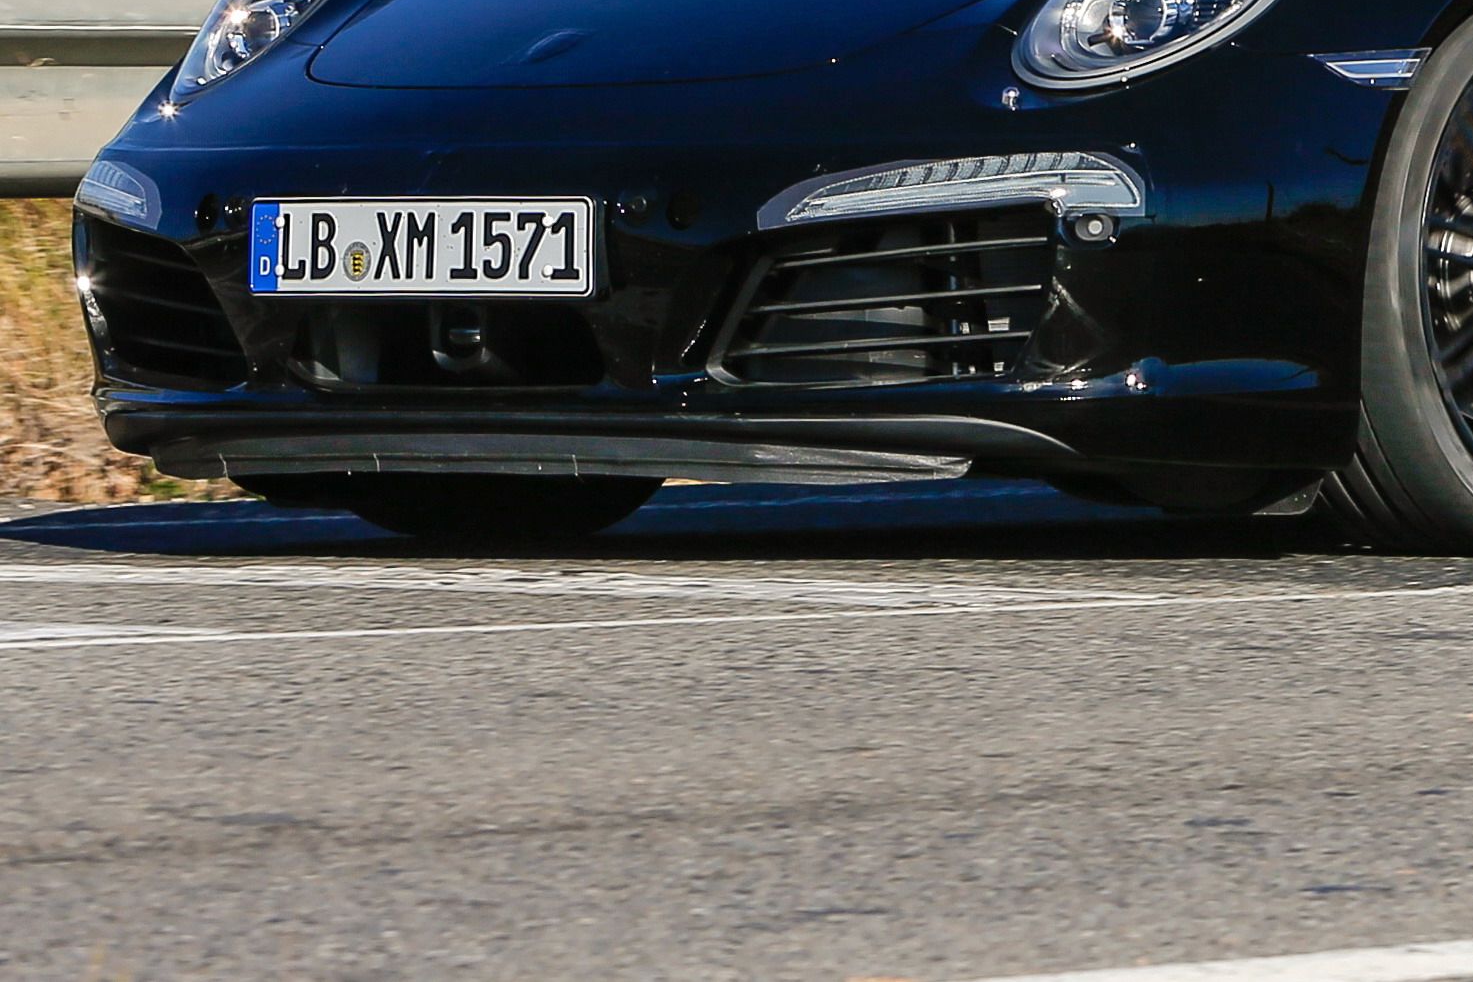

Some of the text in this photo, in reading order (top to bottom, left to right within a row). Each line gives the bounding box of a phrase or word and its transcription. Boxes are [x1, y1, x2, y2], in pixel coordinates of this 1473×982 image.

[258, 255, 271, 276] D
[281, 212, 580, 280] LB XM 1571
